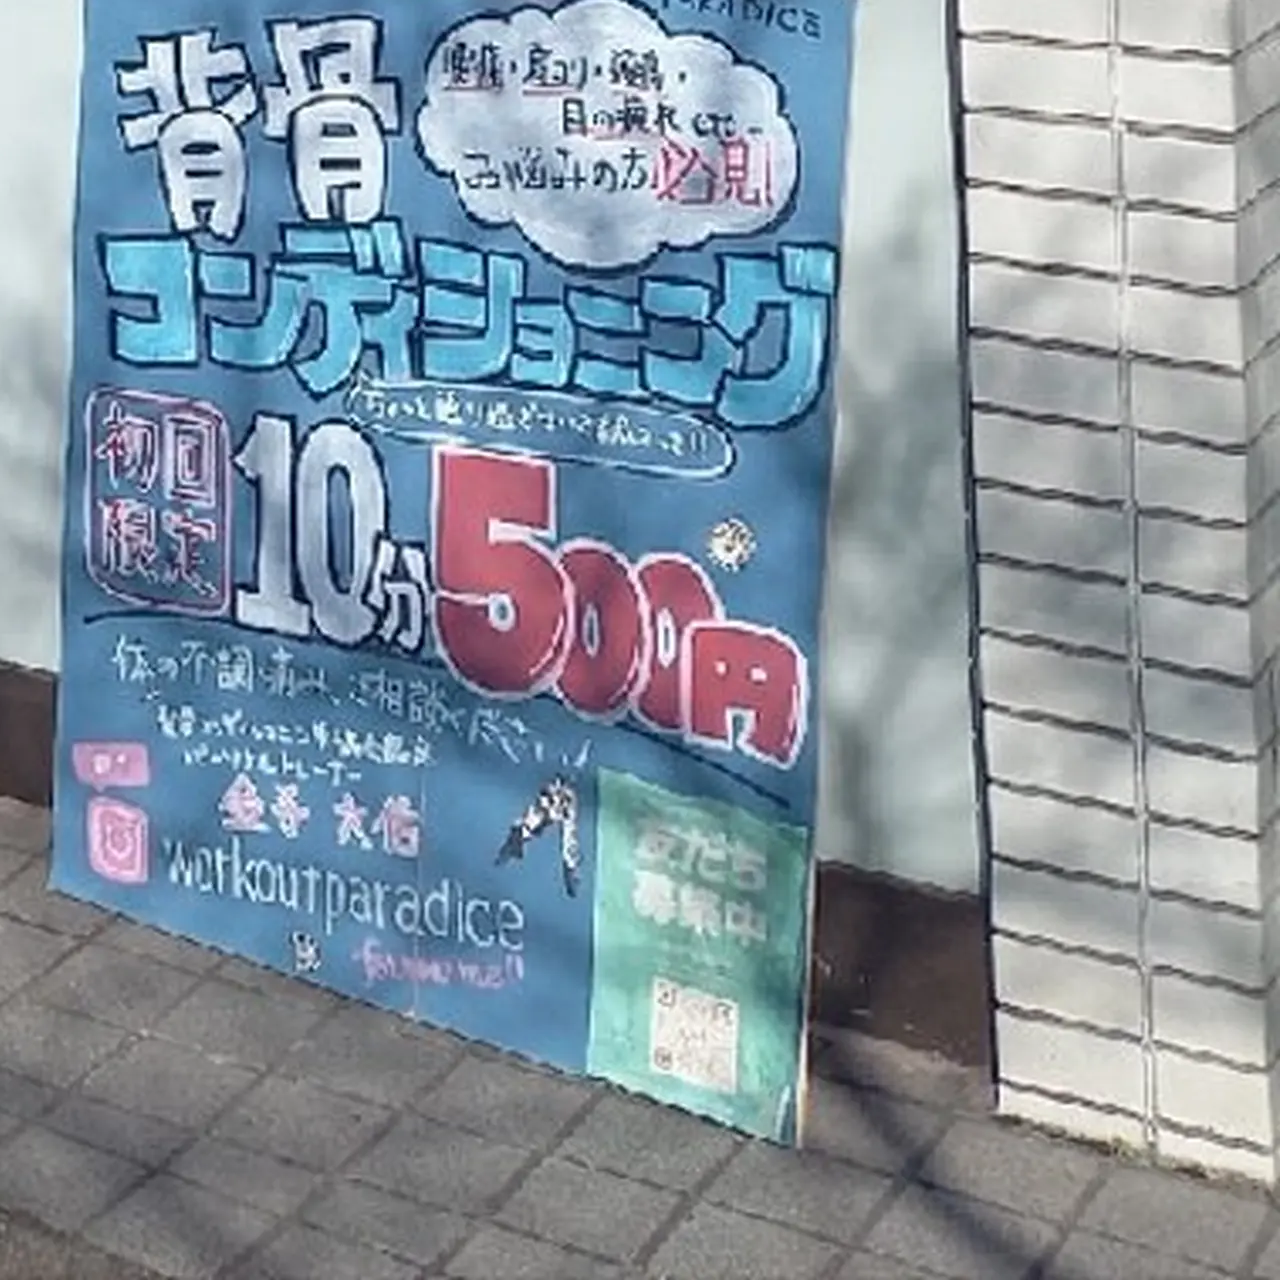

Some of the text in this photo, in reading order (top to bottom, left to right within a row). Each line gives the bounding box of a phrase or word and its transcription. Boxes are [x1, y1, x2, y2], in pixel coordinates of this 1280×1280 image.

[113, 17, 402, 240] 背骨
[96, 220, 840, 430] コンディショニング
[95, 399, 218, 510] 初回
[96, 496, 218, 598] 限定
[233, 412, 810, 771] 10分 500円
[163, 832, 526, 951] workoutparadice
